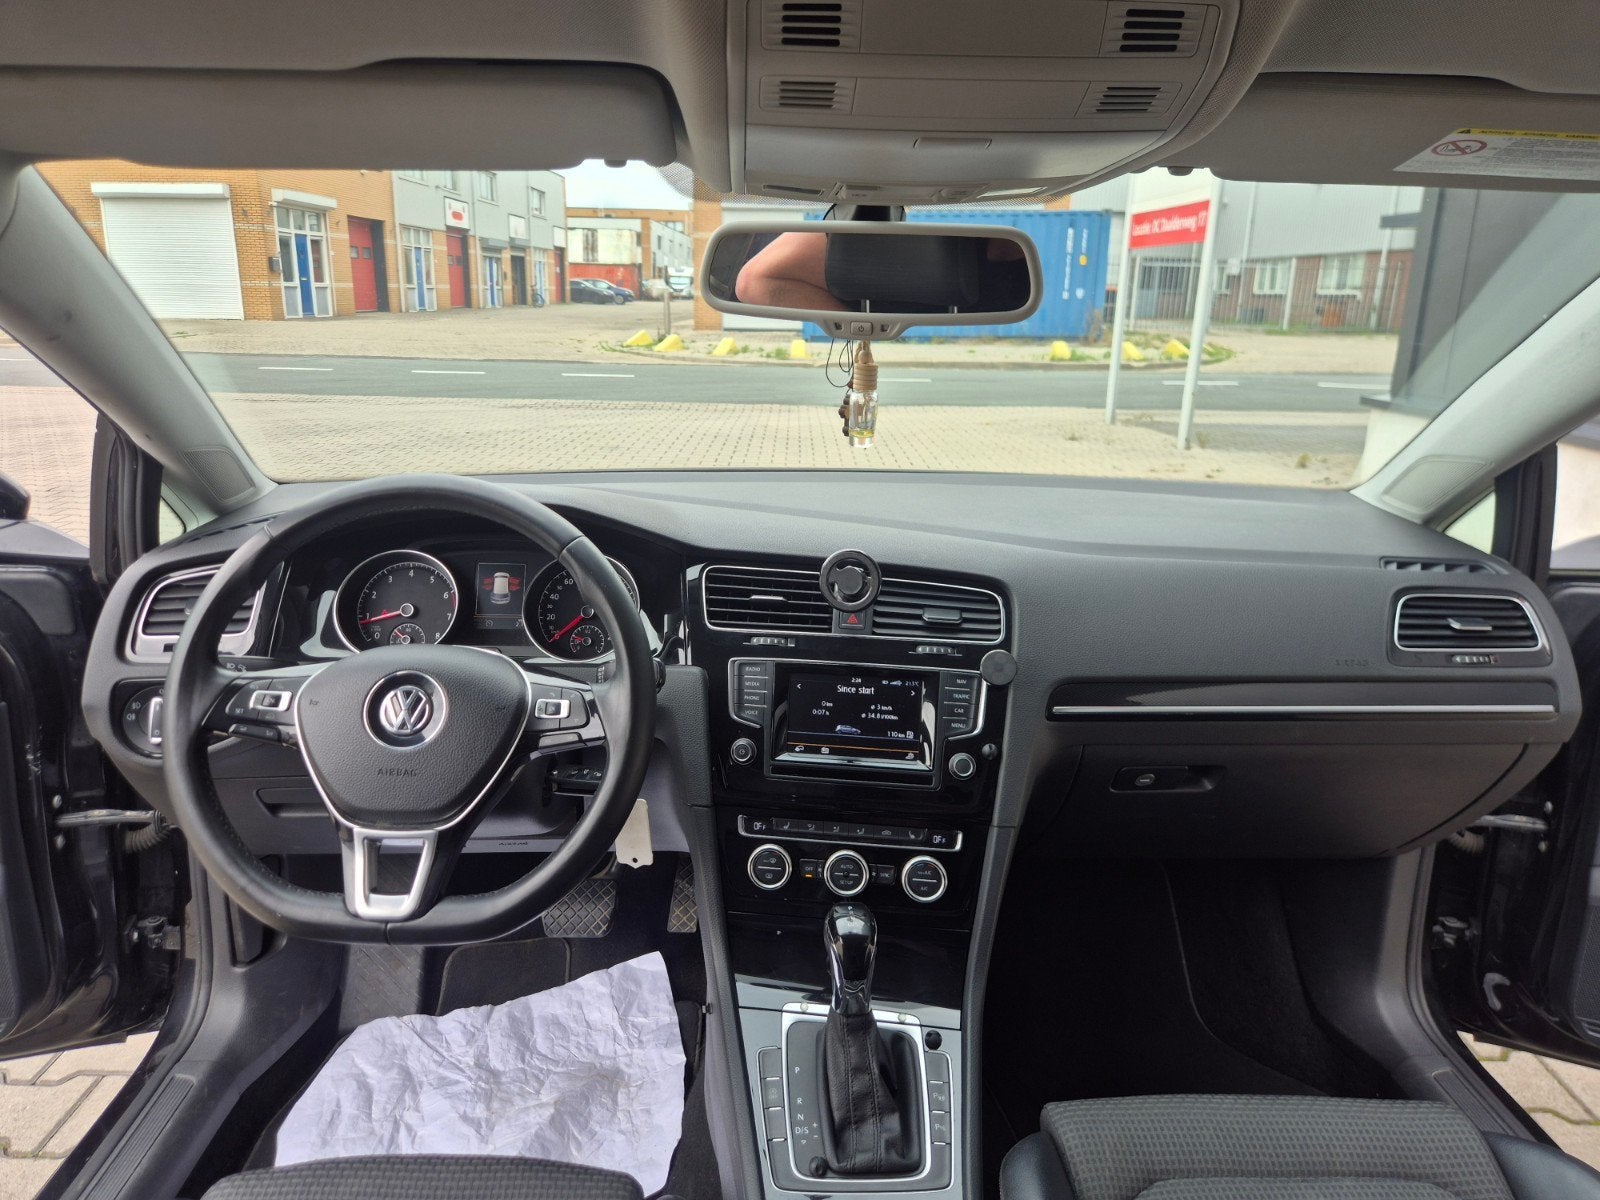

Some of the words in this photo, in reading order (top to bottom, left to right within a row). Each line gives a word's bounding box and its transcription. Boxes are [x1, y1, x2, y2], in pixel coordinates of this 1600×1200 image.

[408, 570, 415, 578] 4
[429, 576, 436, 584] 5
[371, 591, 377, 599] 2
[443, 591, 449, 599] 6
[446, 613, 452, 621] 7
[435, 632, 441, 640] 8
[837, 684, 857, 694] Since
[858, 686, 875, 695] start
[794, 1066, 800, 1074] P
[797, 1113, 804, 1121] N
